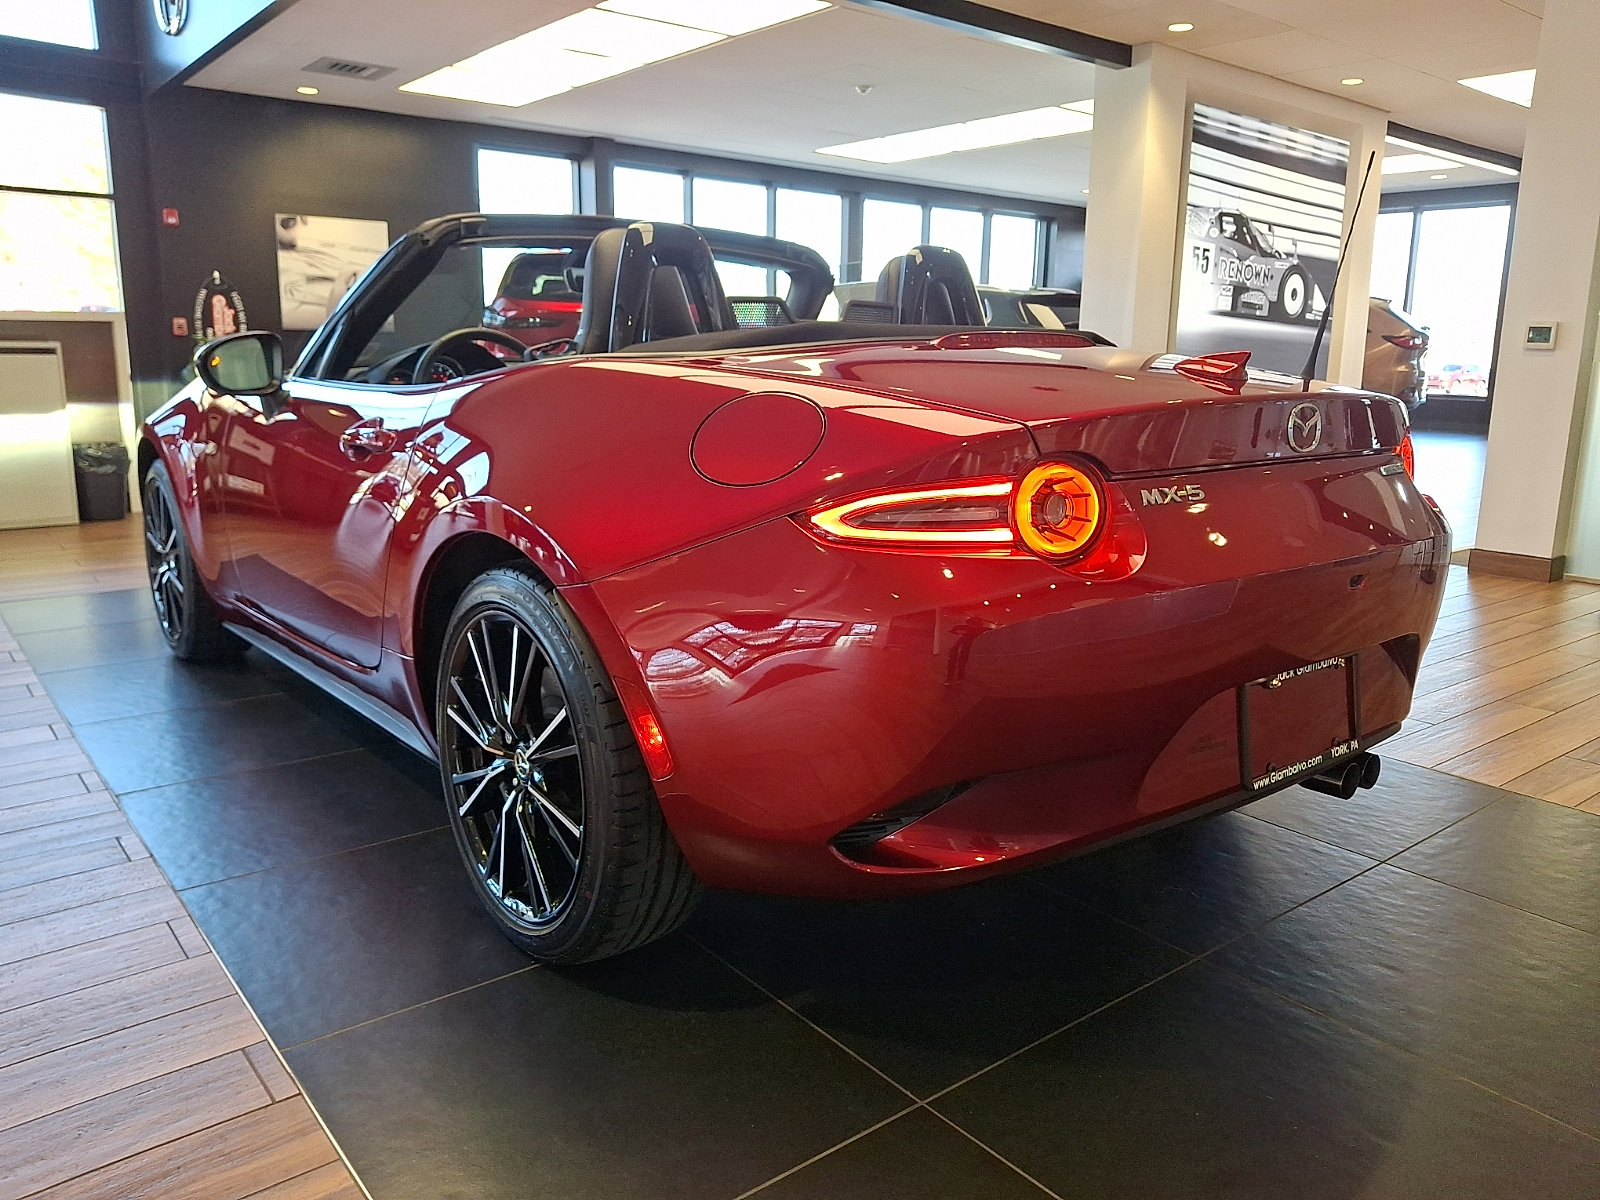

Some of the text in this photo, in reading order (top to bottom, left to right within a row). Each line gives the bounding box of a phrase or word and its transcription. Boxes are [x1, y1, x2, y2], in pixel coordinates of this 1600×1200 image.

[1218, 256, 1272, 287] RENOWN
[1140, 484, 1206, 507] MX-5
[1350, 739, 1359, 751] PA
[1253, 754, 1323, 790] www.Giambalvo.com
